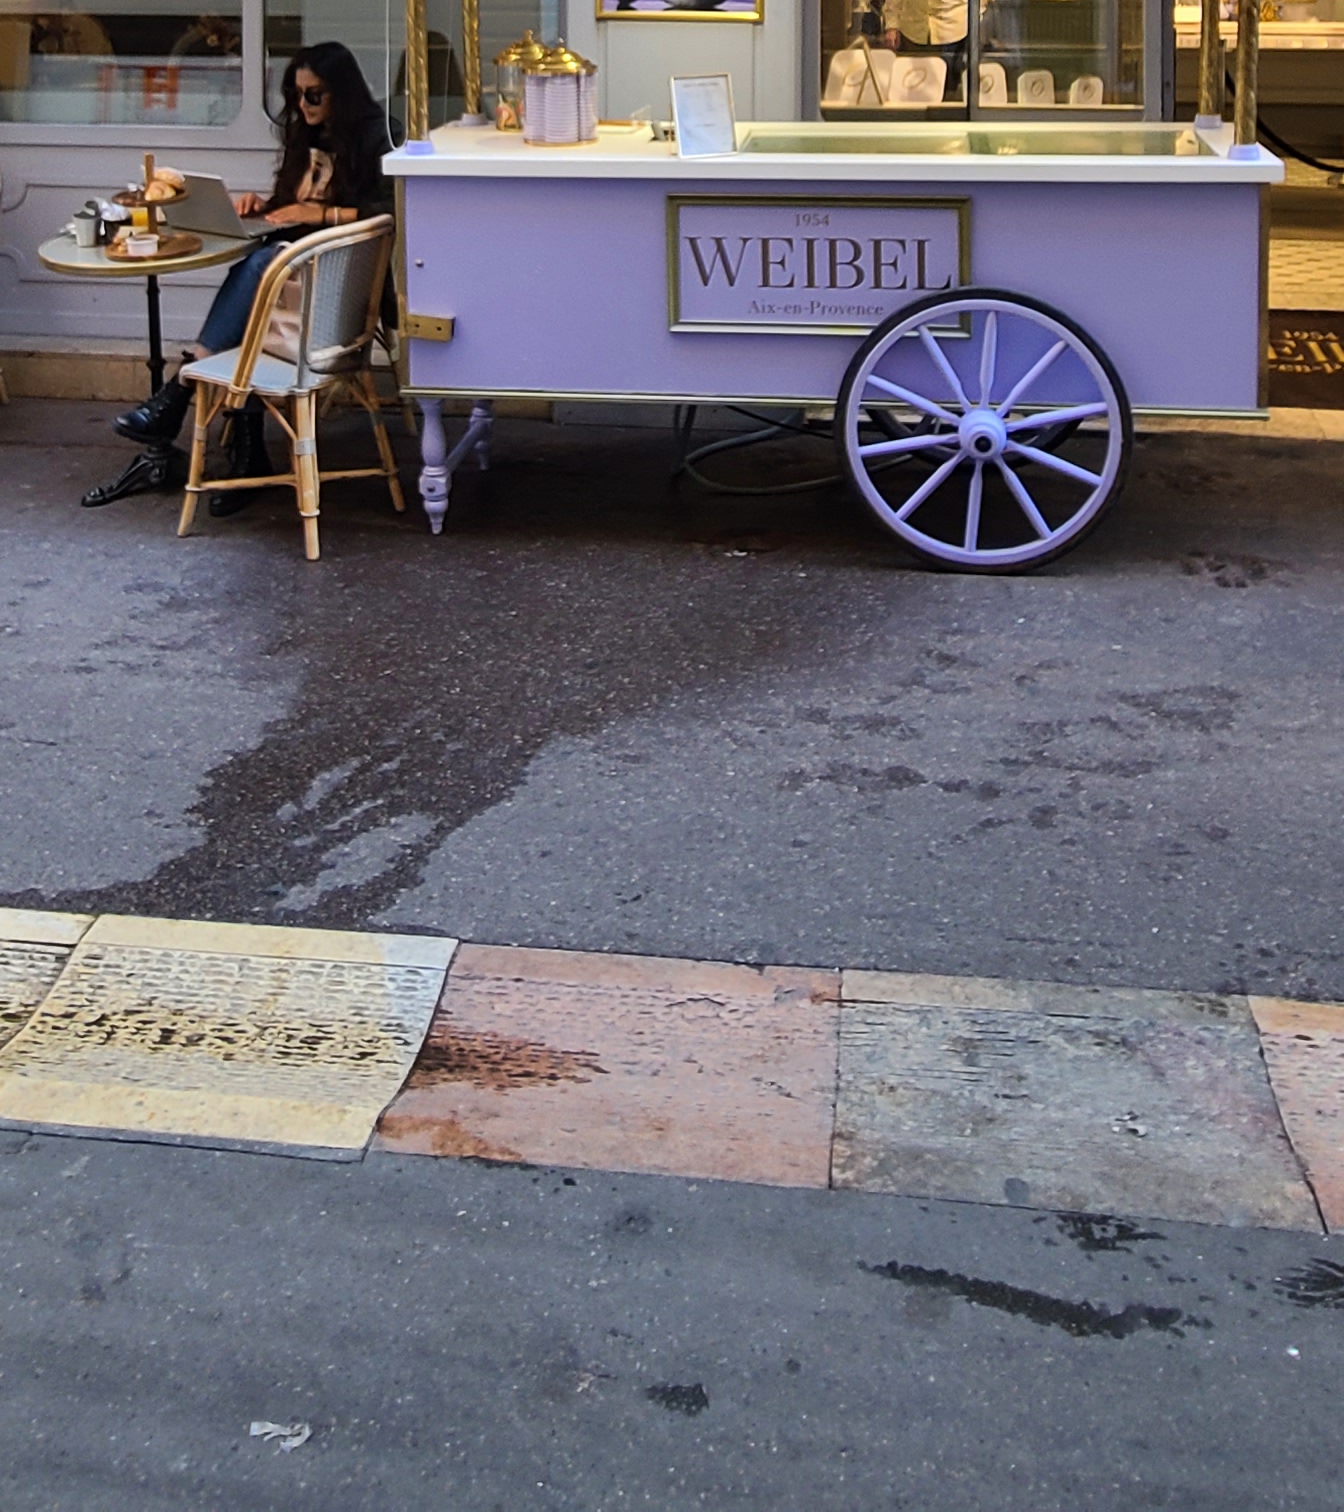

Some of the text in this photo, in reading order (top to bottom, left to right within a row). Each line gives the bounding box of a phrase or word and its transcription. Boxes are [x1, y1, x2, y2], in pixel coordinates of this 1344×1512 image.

[794, 213, 830, 227] 1954
[684, 236, 952, 291] WEIBEL
[747, 299, 885, 316] Aix-en-Provence
